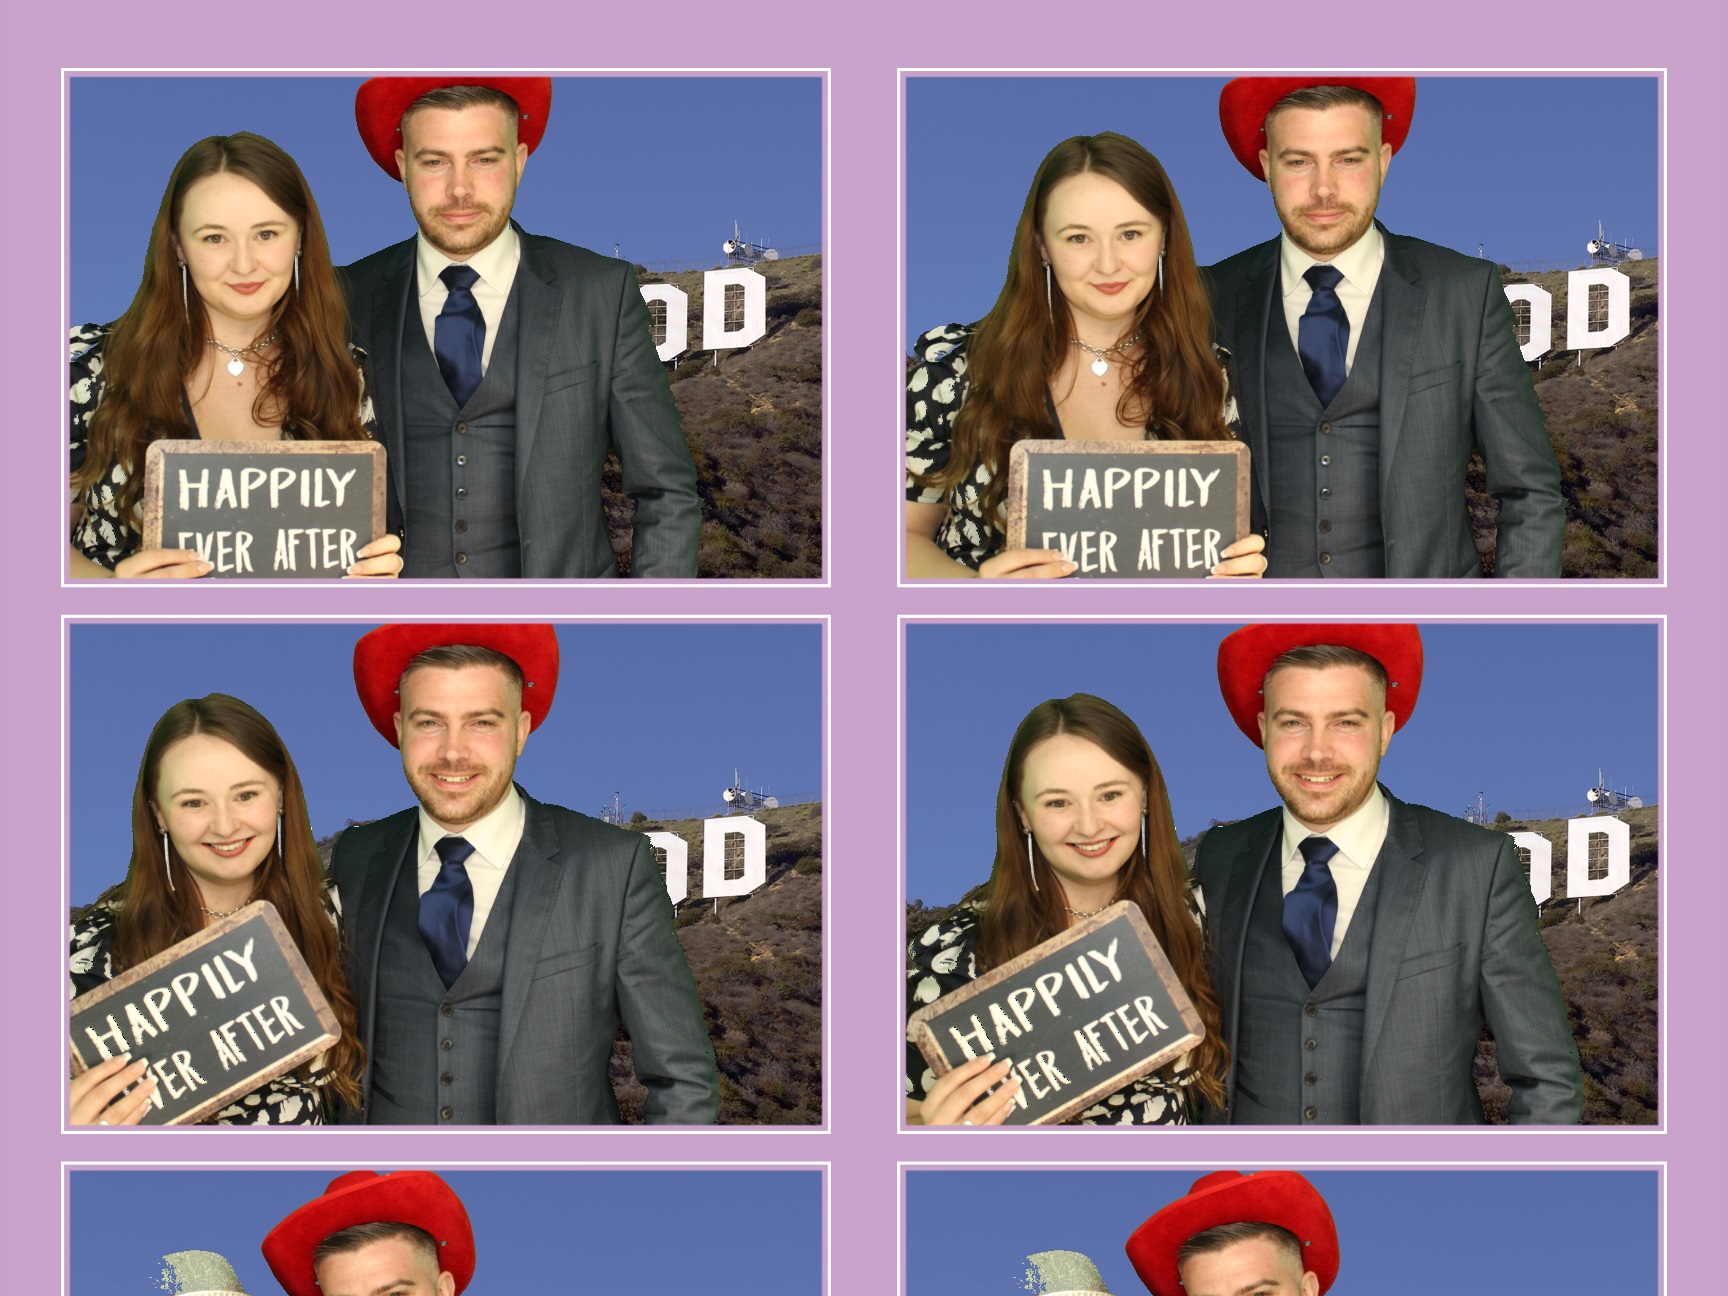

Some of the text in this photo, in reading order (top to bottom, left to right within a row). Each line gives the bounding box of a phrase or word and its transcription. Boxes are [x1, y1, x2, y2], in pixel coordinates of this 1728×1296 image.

[178, 467, 357, 510] HAPPILY
[1042, 467, 1221, 511] HAPPILY
[274, 528, 357, 571] AFTER
[1137, 528, 1222, 571] AFTER
[84, 937, 259, 1060] HAPPILY
[949, 937, 1124, 1060] HAPPILY
[124, 995, 305, 1110] VER AFTER
[987, 995, 1170, 1110] VER AFTER
